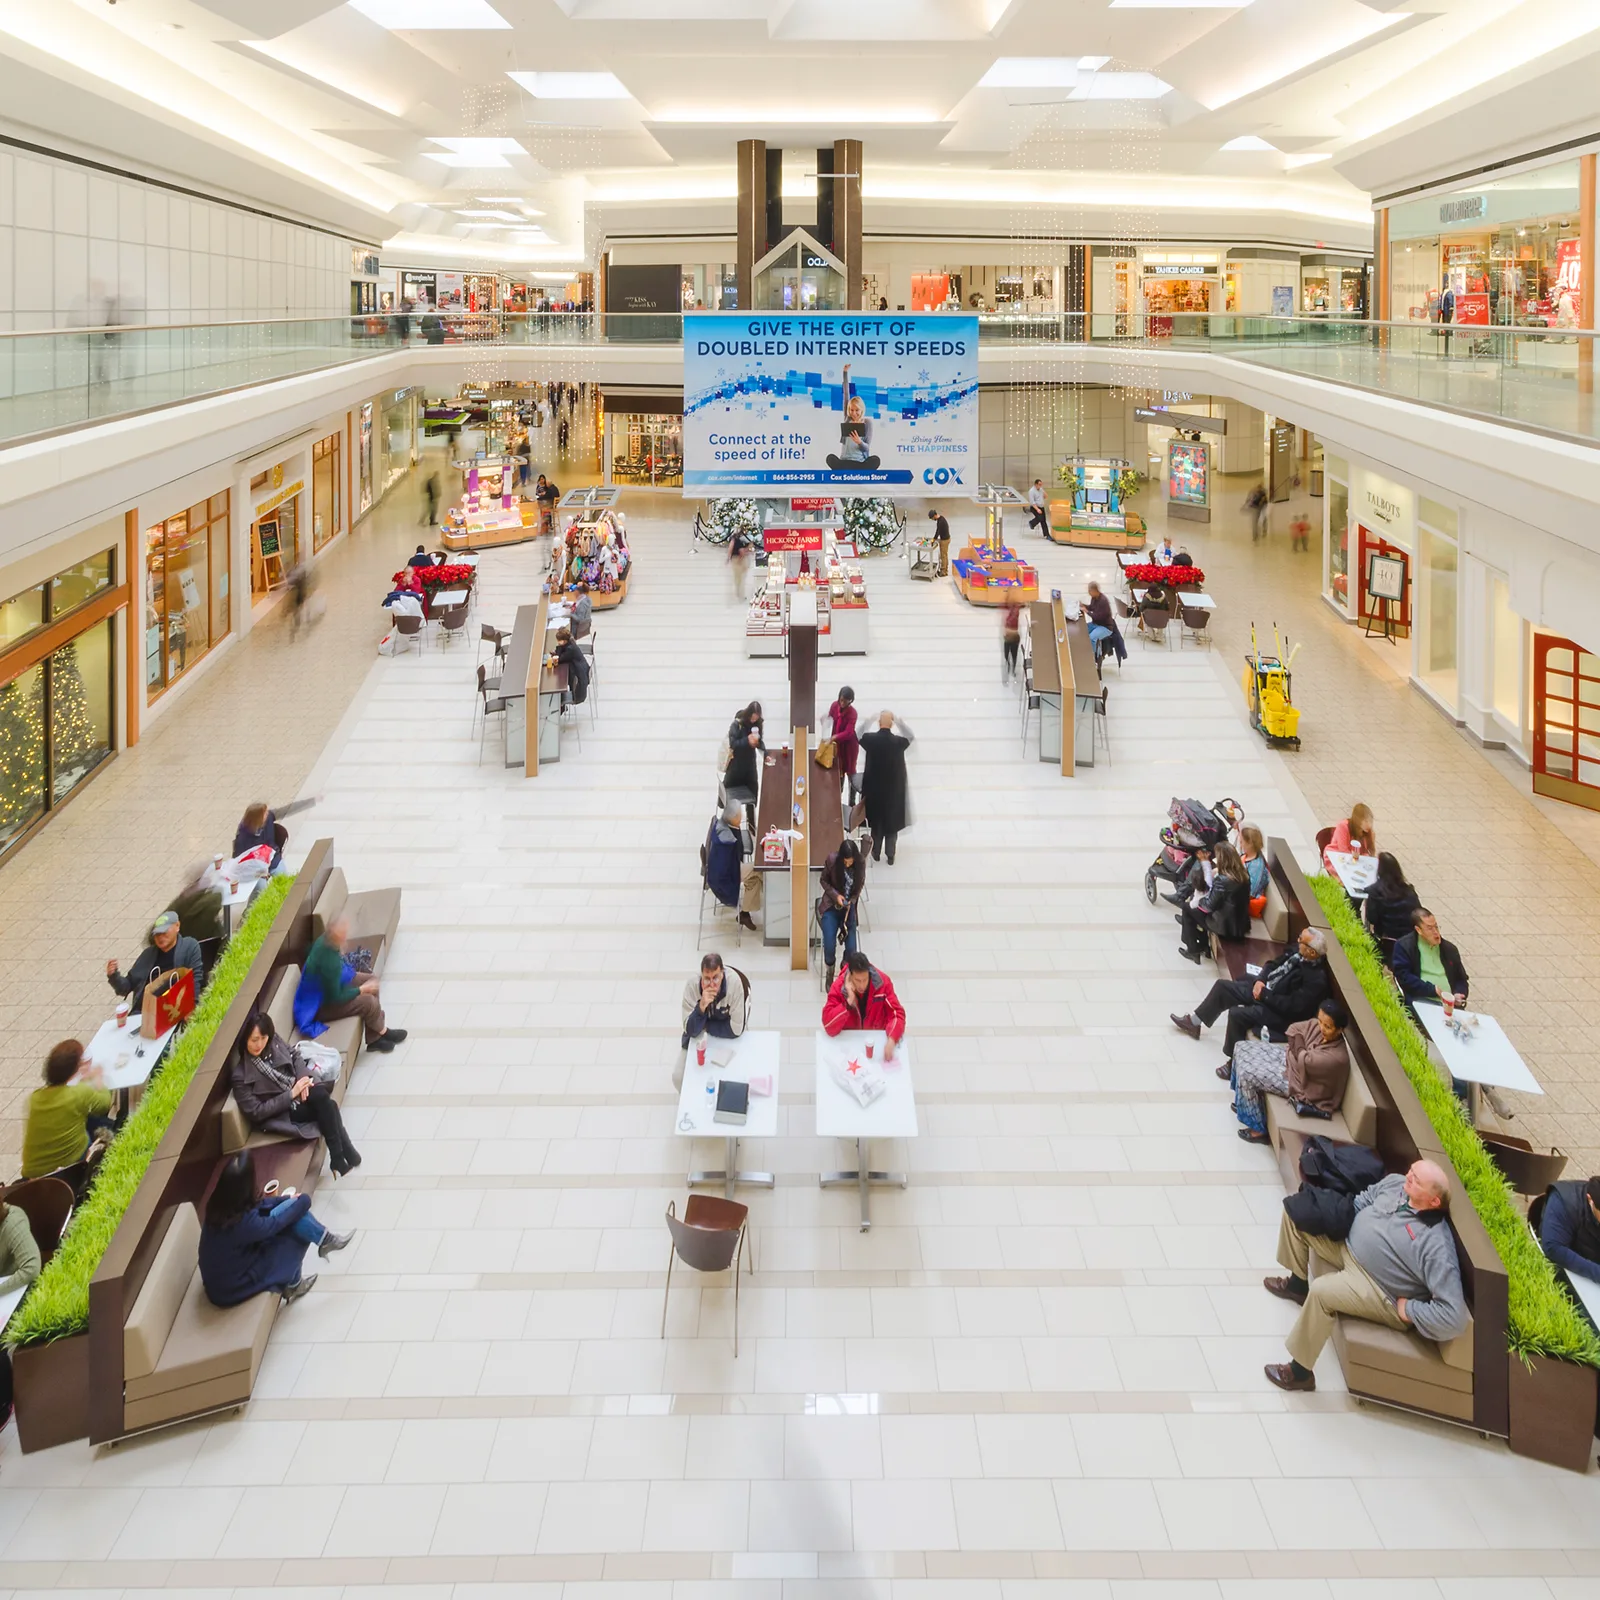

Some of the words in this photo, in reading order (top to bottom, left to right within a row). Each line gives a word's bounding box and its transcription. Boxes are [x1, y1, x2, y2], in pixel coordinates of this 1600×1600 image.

[1155, 266, 1179, 274] YANKEE
[1180, 266, 1204, 274] CANDLE
[1558, 261, 1581, 289] 40
[748, 322, 792, 336] GIVE
[799, 322, 835, 336] THE
[841, 322, 883, 336] GIFT
[890, 322, 916, 336] OF
[698, 341, 789, 356] DOUBLED
[796, 341, 888, 356] INTERNET
[894, 341, 966, 356] SPEEDS
[709, 434, 767, 445] Connect
[771, 434, 785, 445] at
[789, 432, 811, 445] the
[911, 435, 933, 445] Bring
[934, 435, 953, 443] Home
[714, 448, 757, 462] speed
[761, 448, 776, 460] of
[779, 448, 806, 460] life!
[896, 445, 916, 453] THE
[917, 445, 968, 453] HAPPINESS
[707, 474, 758, 482] cox.com/internet
[923, 467, 965, 485] COX
[1366, 491, 1401, 518] TALBOTS
